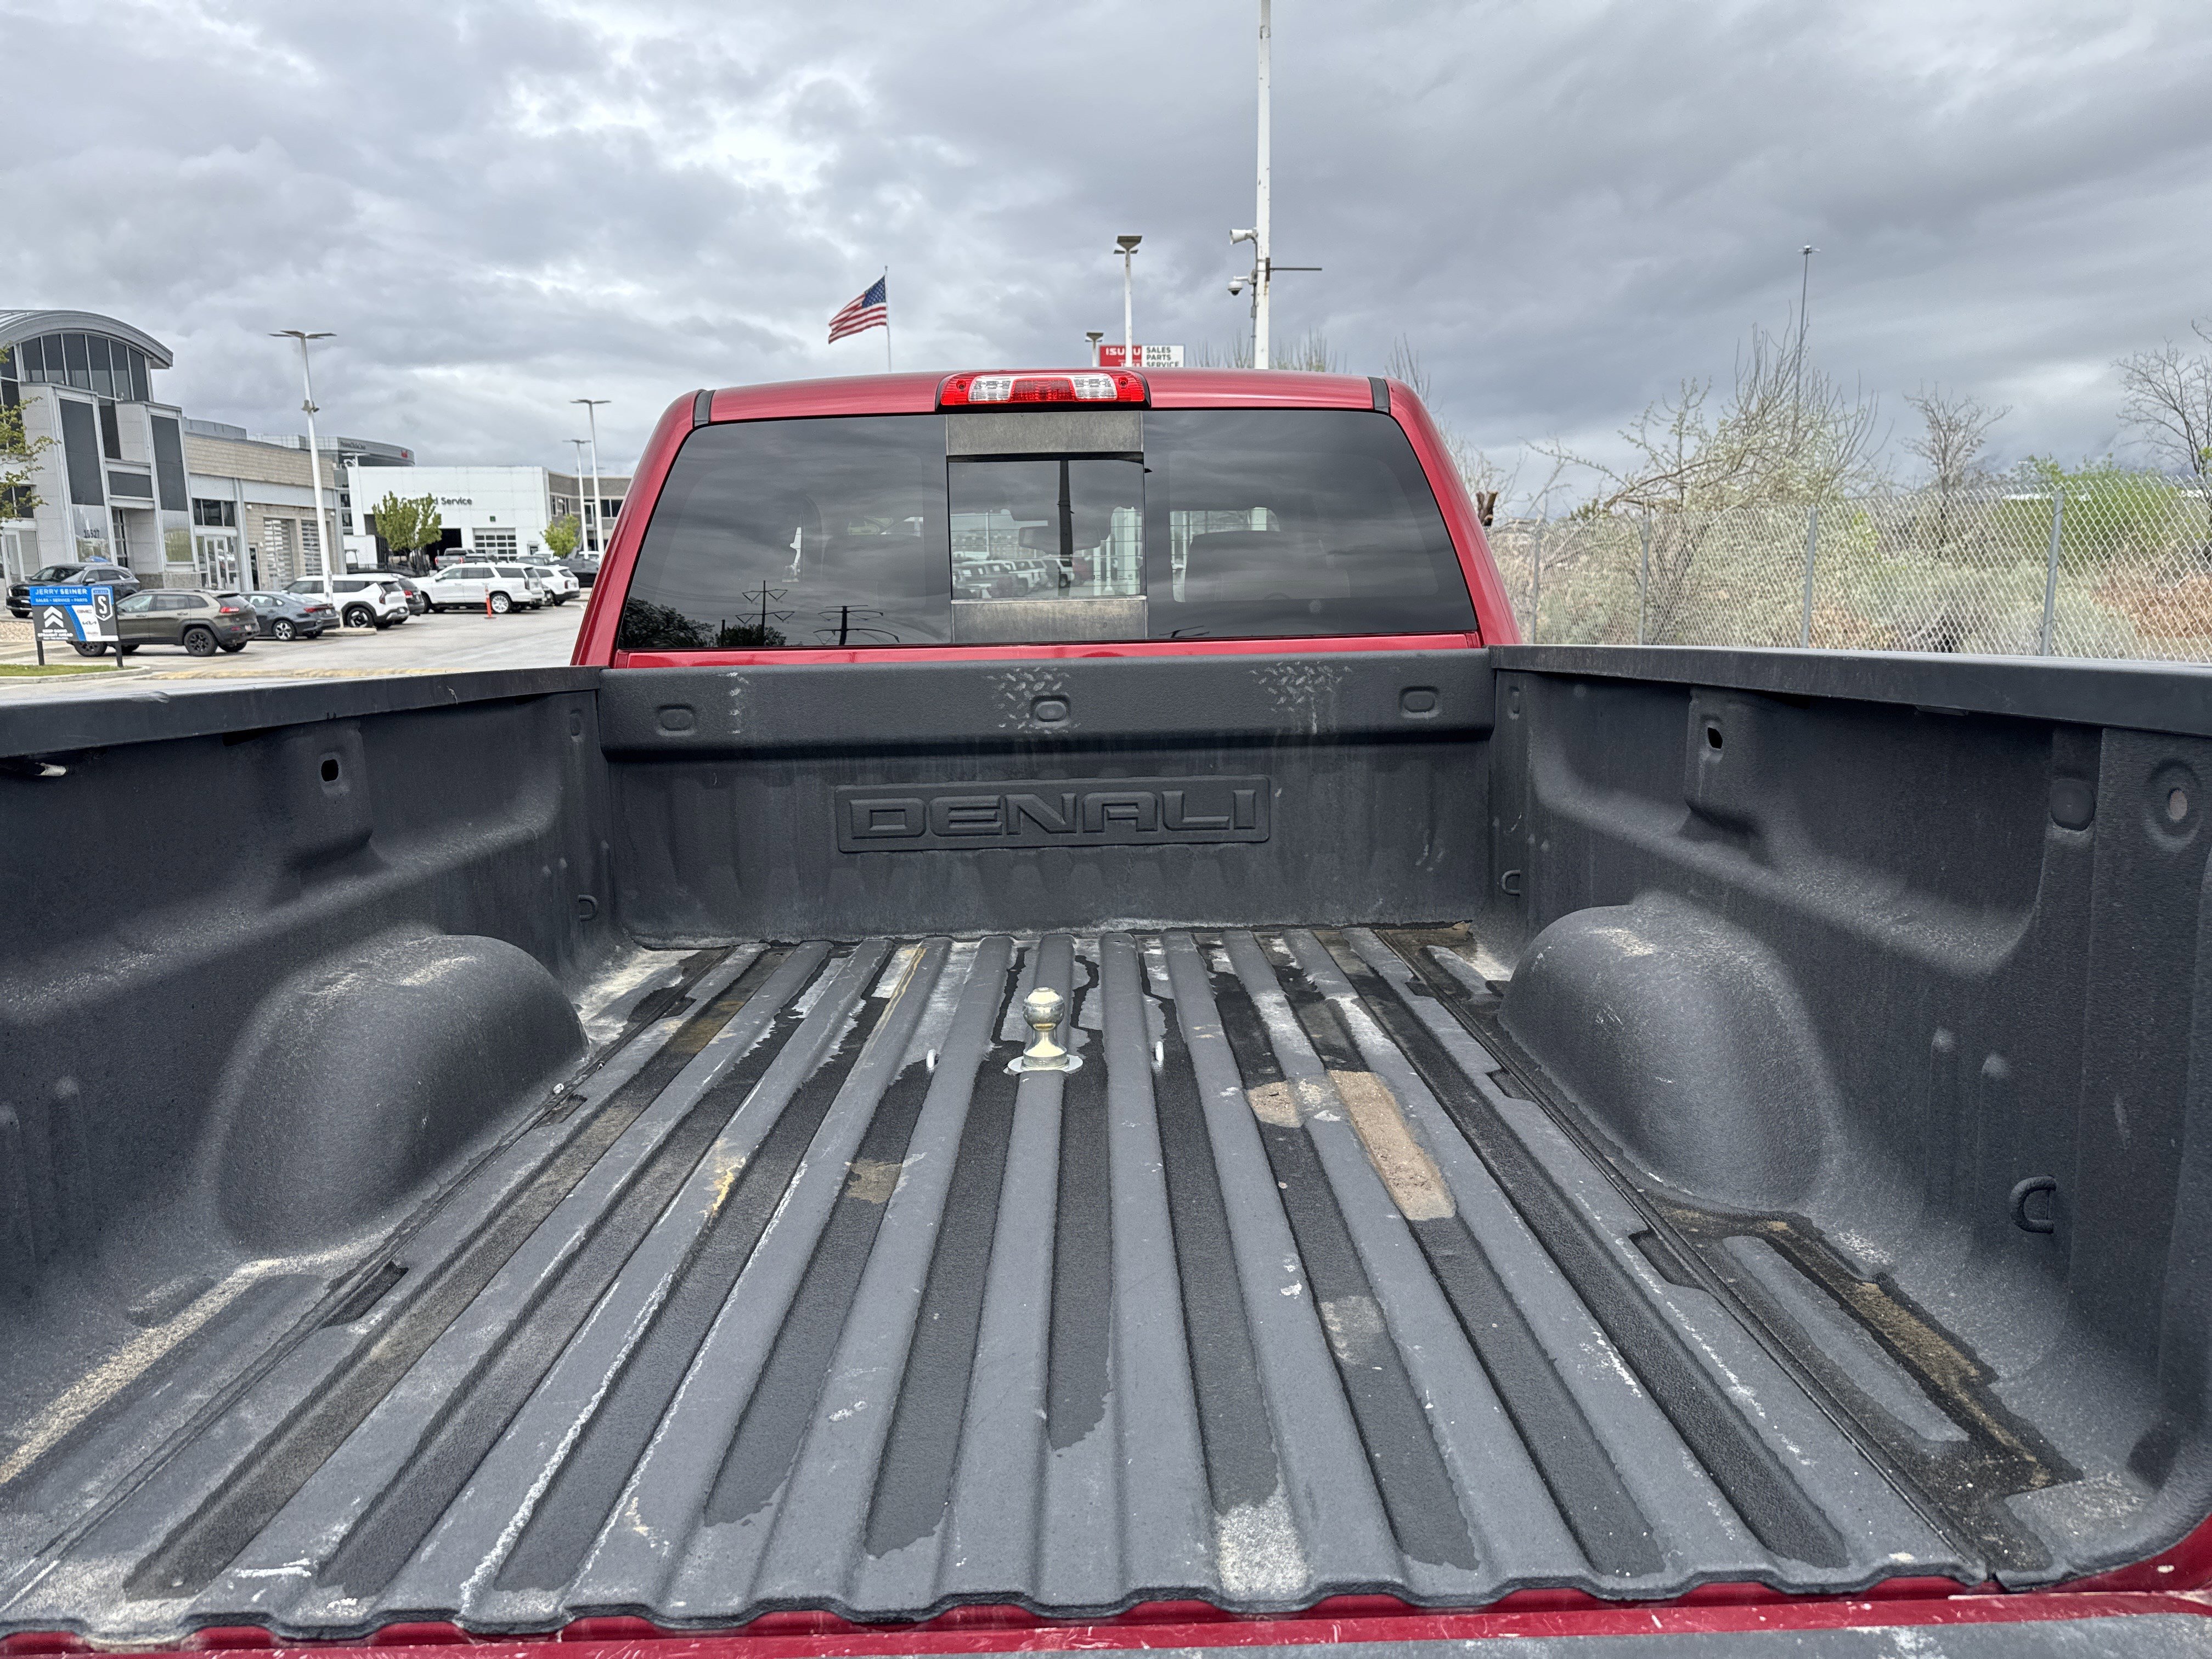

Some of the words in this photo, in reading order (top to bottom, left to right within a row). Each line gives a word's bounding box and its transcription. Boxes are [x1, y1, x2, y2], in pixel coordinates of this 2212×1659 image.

[1105, 347, 1141, 356] ISUU
[441, 496, 472, 505] Service
[850, 788, 1256, 839] DENALI
